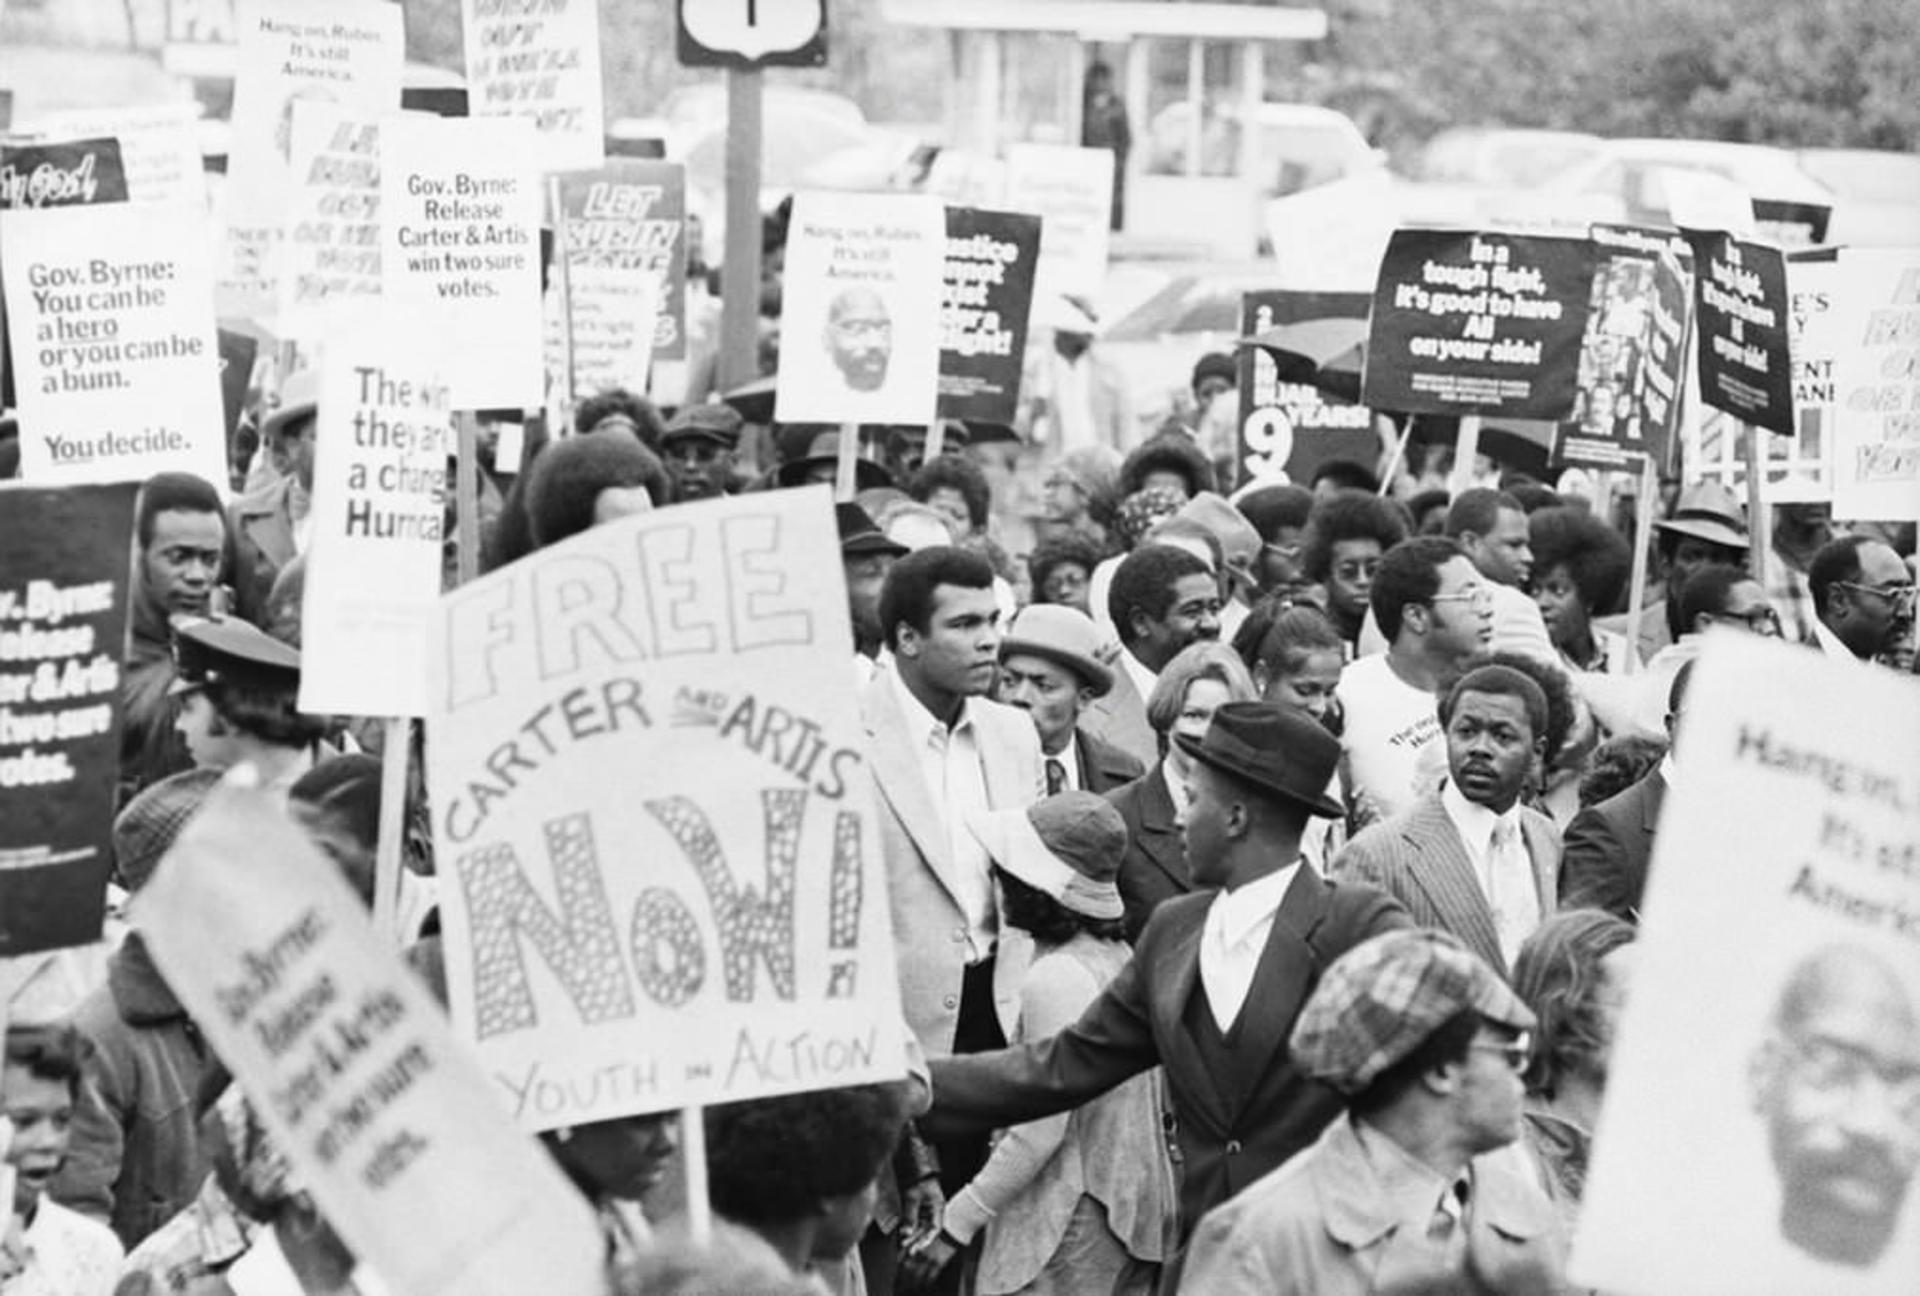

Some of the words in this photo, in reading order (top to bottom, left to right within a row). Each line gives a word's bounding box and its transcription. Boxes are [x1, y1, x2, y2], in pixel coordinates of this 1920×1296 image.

[407, 174, 452, 196] Gov.
[455, 174, 517, 198] Byrne:
[425, 200, 503, 221] Release
[583, 182, 664, 220] LET
[398, 226, 461, 247] Carter
[465, 225, 480, 247] &
[484, 223, 529, 245] Artis
[407, 251, 441, 272] win
[444, 252, 482, 271] two
[484, 253, 525, 271] sure
[1470, 236, 1494, 263] In
[1494, 244, 1510, 264] a
[29, 263, 86, 288] Gov.
[90, 259, 174, 289] Byrne:
[437, 278, 500, 298] votes.
[1422, 259, 1489, 291] tough
[1491, 264, 1547, 297] fight,
[33, 289, 83, 315] You
[87, 291, 132, 311] can
[136, 284, 166, 307] be
[1429, 291, 1488, 316] good
[1489, 291, 1513, 317] to
[37, 323, 52, 342] a
[57, 316, 119, 341] hero
[39, 348, 69, 368] or
[70, 344, 121, 371] you
[124, 339, 169, 361] can
[171, 334, 204, 356] be
[1409, 336, 1438, 357] on
[1437, 339, 1491, 362] your
[1490, 338, 1543, 365] side!
[42, 375, 58, 394] a
[62, 368, 131, 392] bum.
[354, 366, 412, 407] The
[45, 434, 94, 461] You
[97, 427, 192, 457] decide.
[349, 462, 367, 490] a
[447, 512, 814, 712] FREE
[445, 677, 654, 845] CARTER
[718, 694, 862, 800] ARTIS
[1736, 722, 1846, 794] Hang
[494, 1060, 659, 1122] YOUTH
[723, 1025, 880, 1092] ACTION
